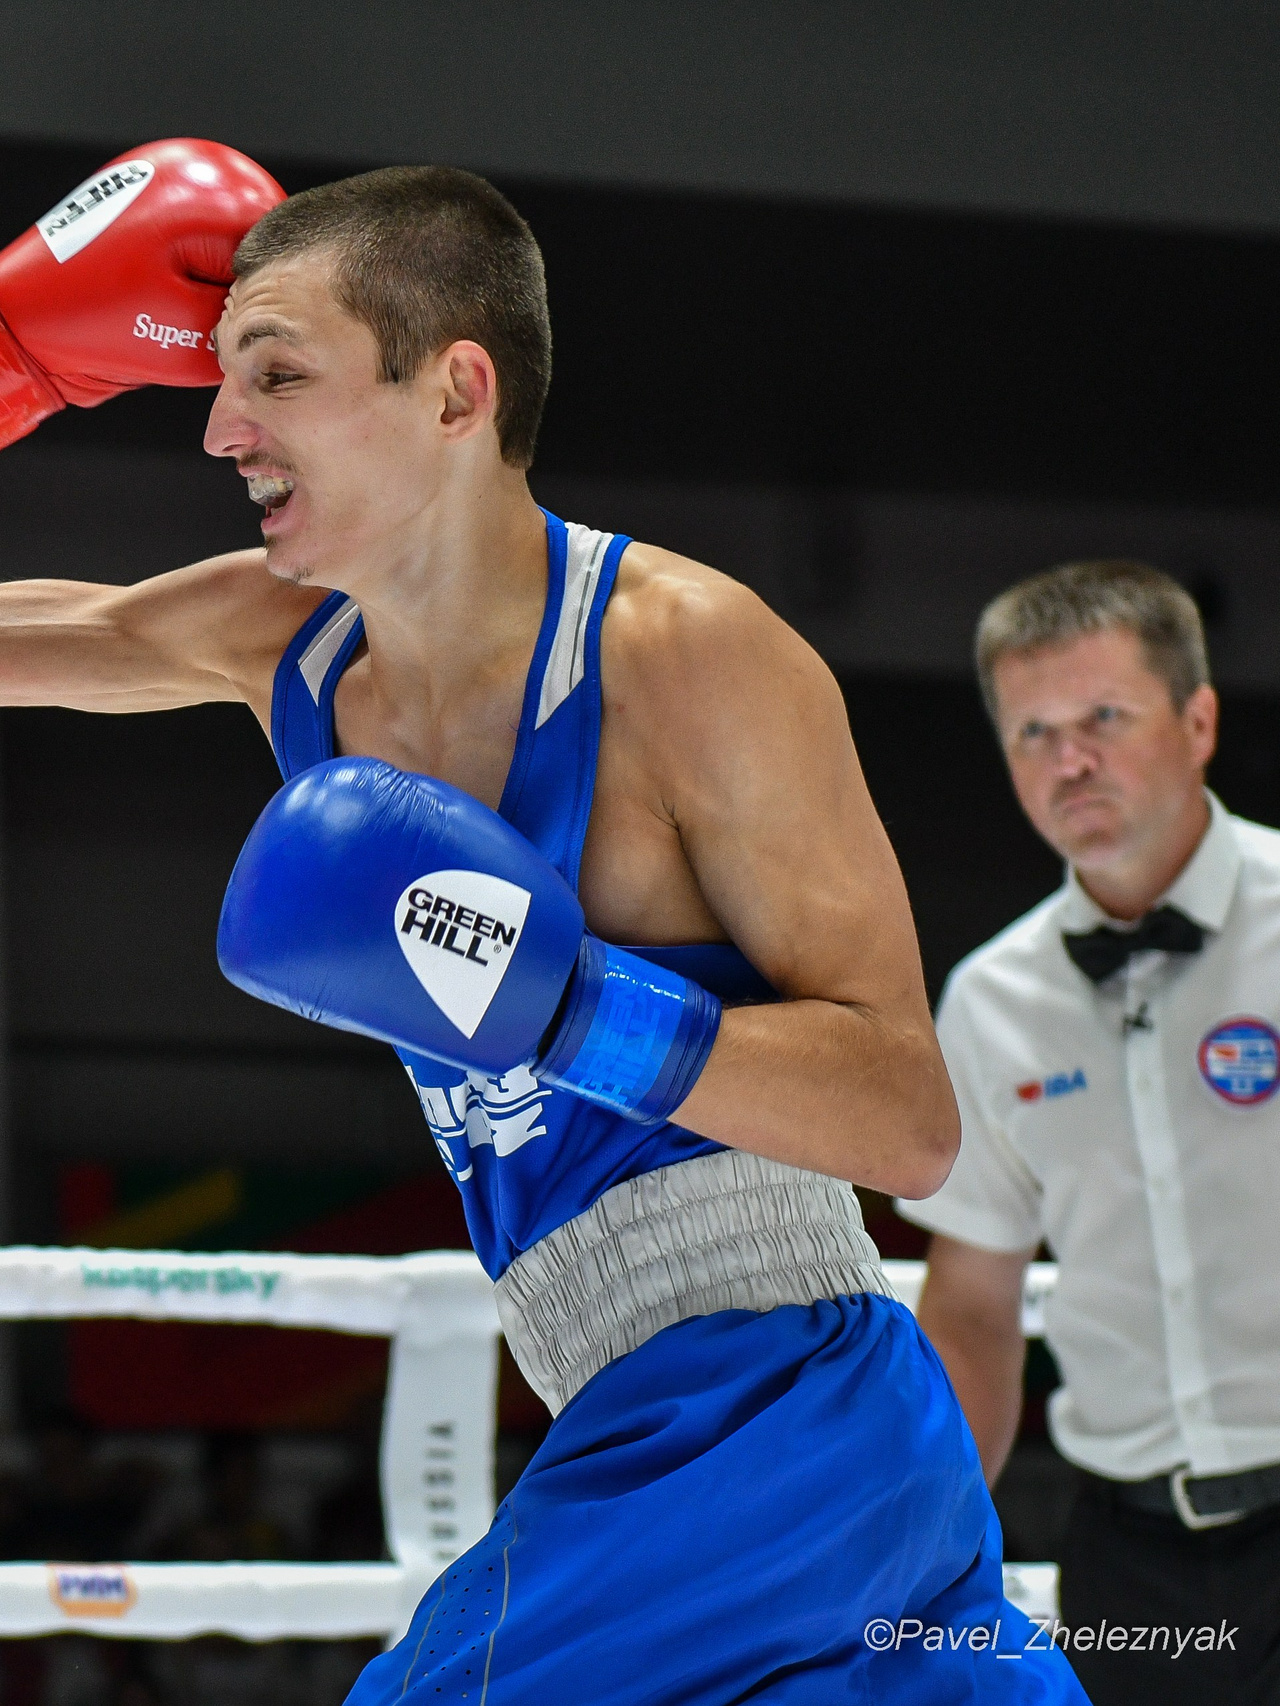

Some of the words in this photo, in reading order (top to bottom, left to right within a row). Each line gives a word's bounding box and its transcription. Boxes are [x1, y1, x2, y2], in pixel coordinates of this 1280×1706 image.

[133, 313, 204, 350] Super
[401, 909, 489, 967] HILL
[407, 887, 517, 946] GREEN
